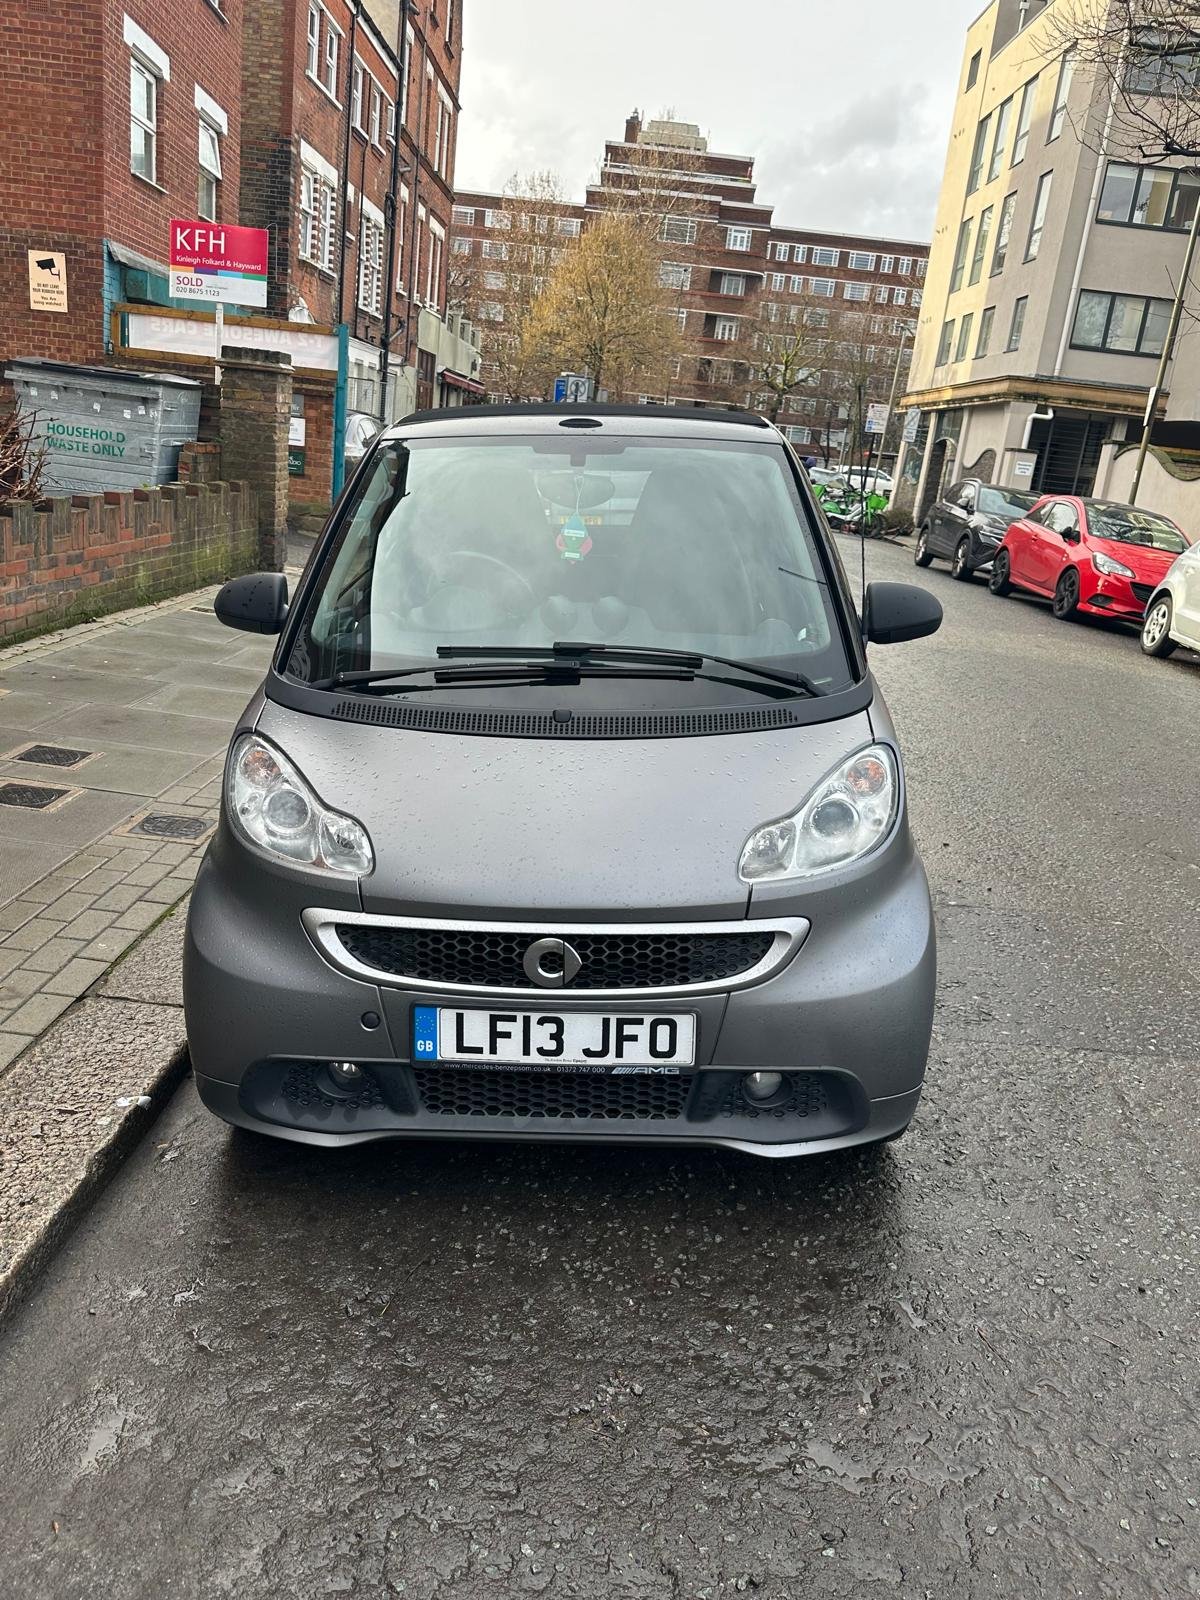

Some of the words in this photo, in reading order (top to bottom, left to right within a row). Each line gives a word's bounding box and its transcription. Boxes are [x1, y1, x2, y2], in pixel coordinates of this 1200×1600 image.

[176, 227, 225, 254] KFH
[176, 255, 201, 264] Kinleigh
[202, 258, 225, 266] Folkard
[233, 261, 262, 270] Hayward
[176, 276, 203, 286] SOLD
[205, 289, 220, 297] 1123
[47, 423, 126, 443] HOUSEHOLD
[47, 438, 89, 453] WASTE
[92, 443, 125, 457] ONLY
[456, 1012, 564, 1057] LF13
[582, 1017, 678, 1059] JFO
[417, 1040, 433, 1052] GB
[445, 1063, 551, 1072] www.mercedes-benzepsom.co.uk
